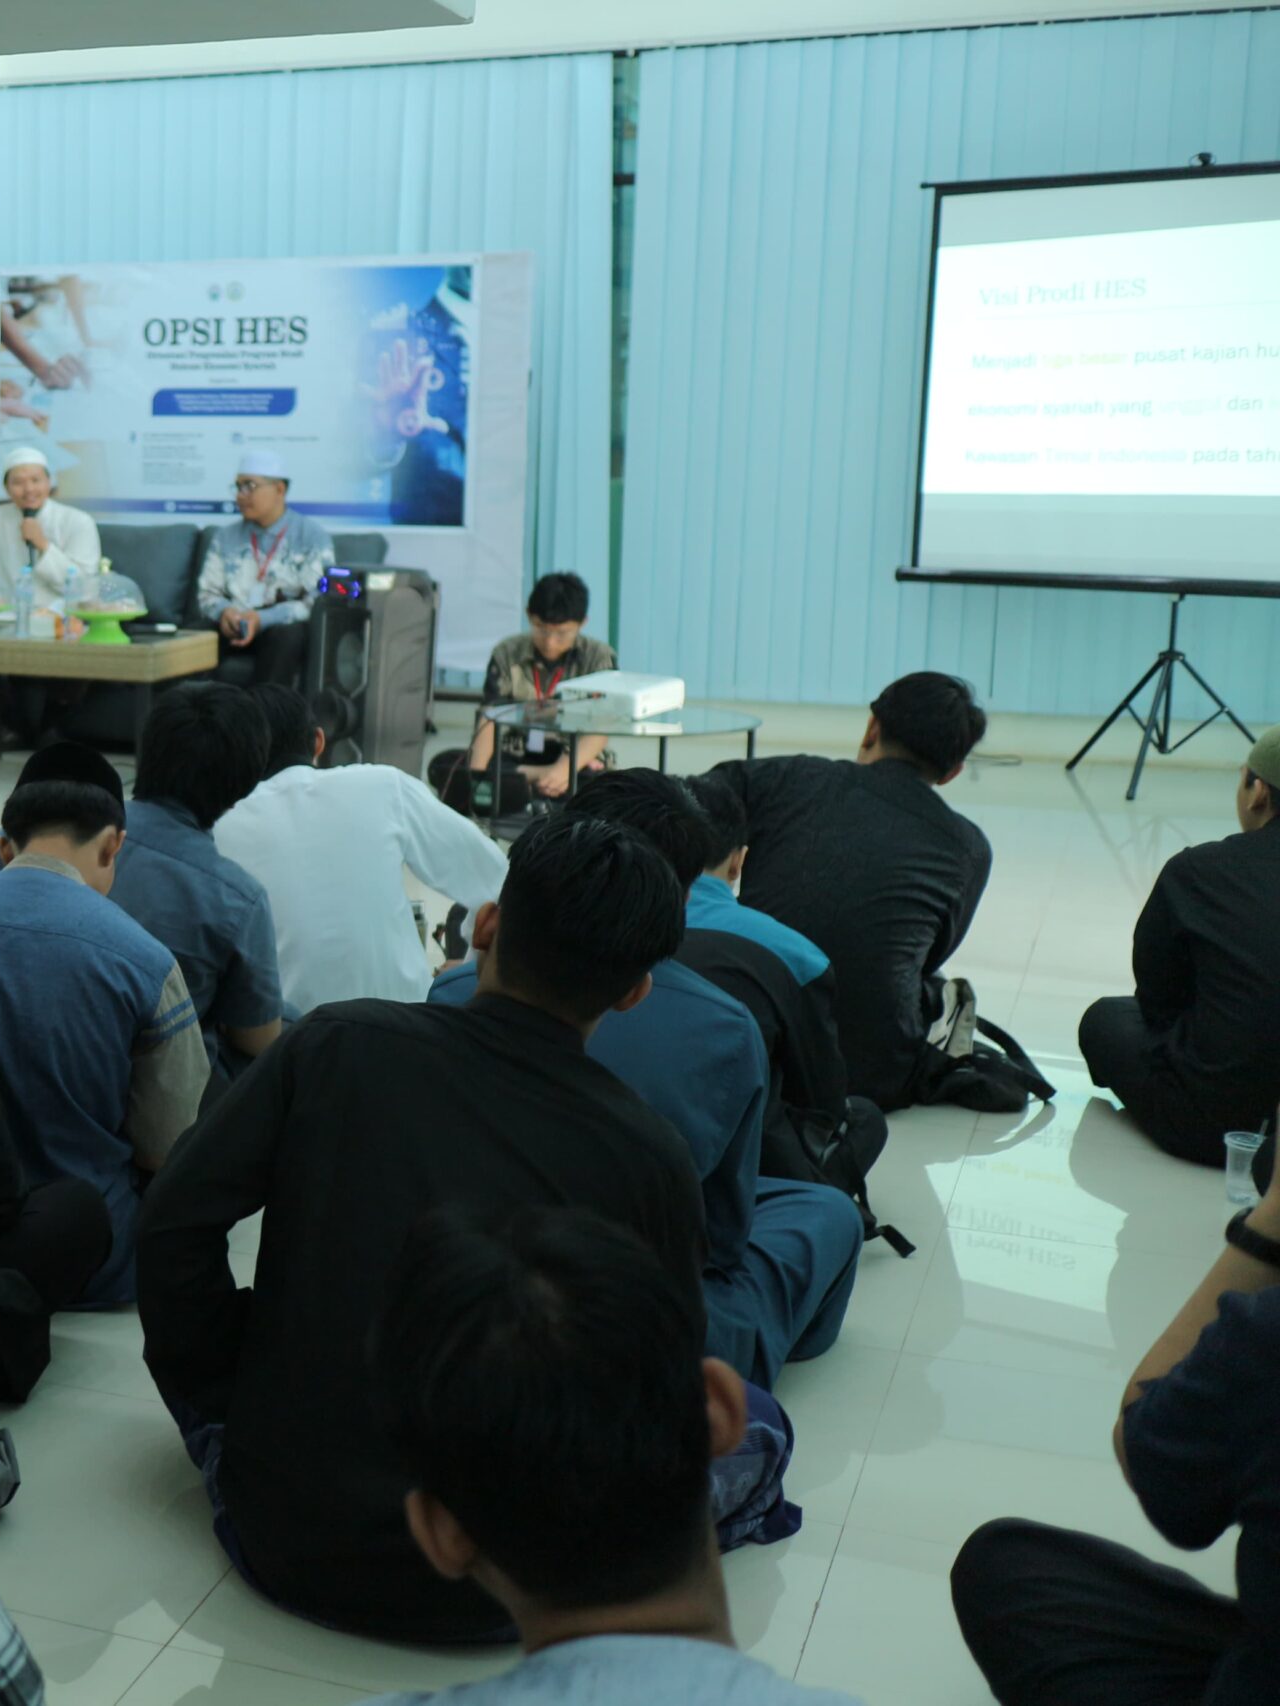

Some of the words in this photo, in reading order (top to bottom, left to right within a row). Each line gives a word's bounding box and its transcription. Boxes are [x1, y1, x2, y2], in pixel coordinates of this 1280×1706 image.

[979, 287, 1020, 306] Visi
[1027, 281, 1086, 304] Prodi
[1094, 278, 1147, 299] HES
[142, 317, 225, 346] OPSI
[234, 316, 309, 345] HES
[972, 353, 1037, 373] Menjadi
[1134, 347, 1187, 365] pusat
[1192, 344, 1249, 364] kajian
[1043, 399, 1104, 418] syariah
[1109, 400, 1152, 418] yang
[1227, 396, 1263, 411] dan
[965, 447, 1039, 464] Kawasan
[1192, 446, 1240, 465] pada
